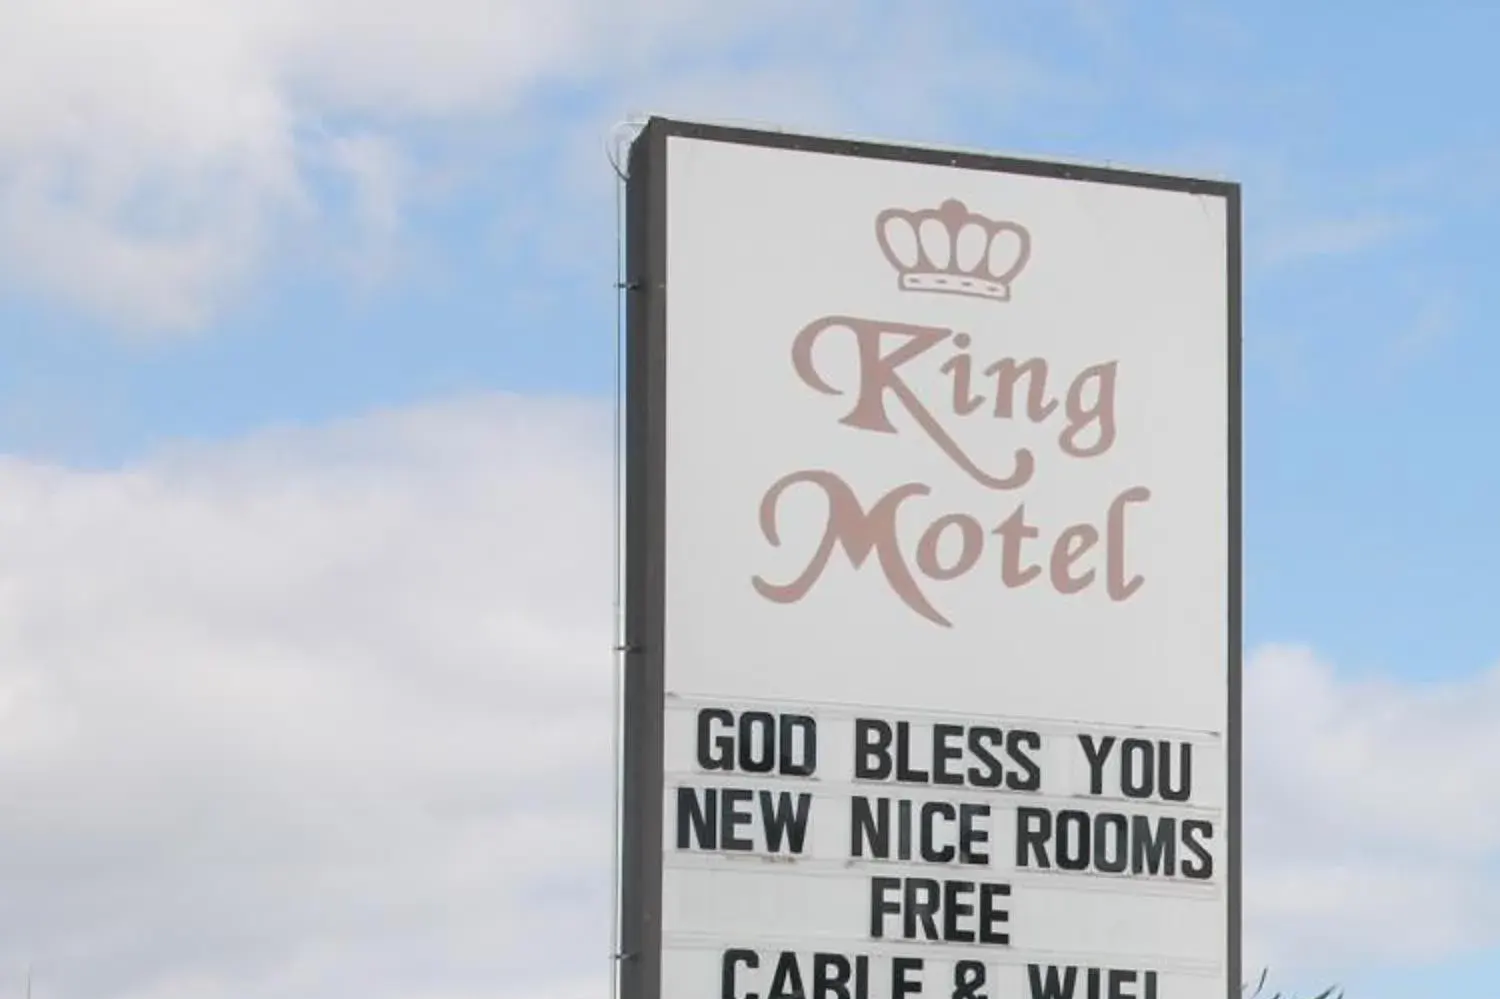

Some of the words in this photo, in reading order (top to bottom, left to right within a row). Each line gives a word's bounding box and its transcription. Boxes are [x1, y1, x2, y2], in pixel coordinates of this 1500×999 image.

[791, 315, 1118, 489] King
[751, 469, 1152, 628] Motel
[697, 707, 817, 777] GOD
[854, 718, 1041, 792] BLESS
[1078, 733, 1192, 801] YOU
[676, 787, 812, 853] NEW
[850, 795, 991, 865] NICE
[1015, 806, 1213, 880] ROOMS
[870, 876, 1011, 945] FREE
